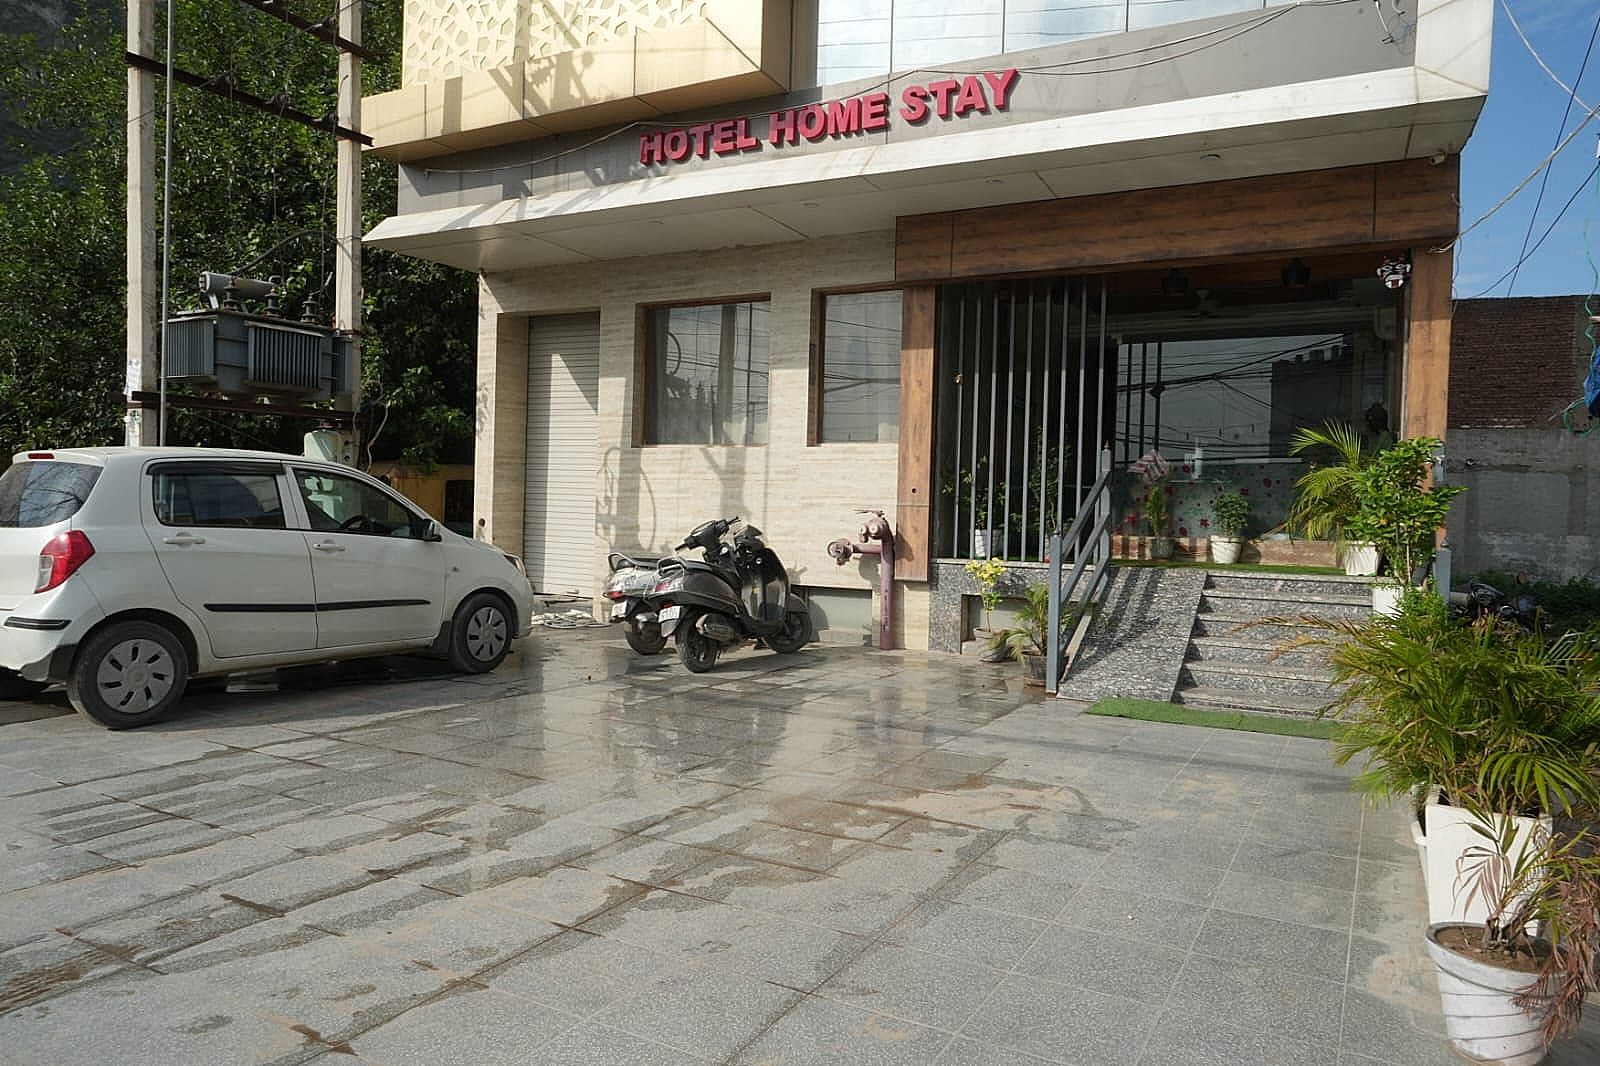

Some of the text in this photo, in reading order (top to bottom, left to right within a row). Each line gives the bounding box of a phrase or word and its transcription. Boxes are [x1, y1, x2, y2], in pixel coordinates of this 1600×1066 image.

[640, 117, 760, 165] HOTEL
[768, 92, 890, 146] HOME
[900, 68, 1018, 124] STAY
